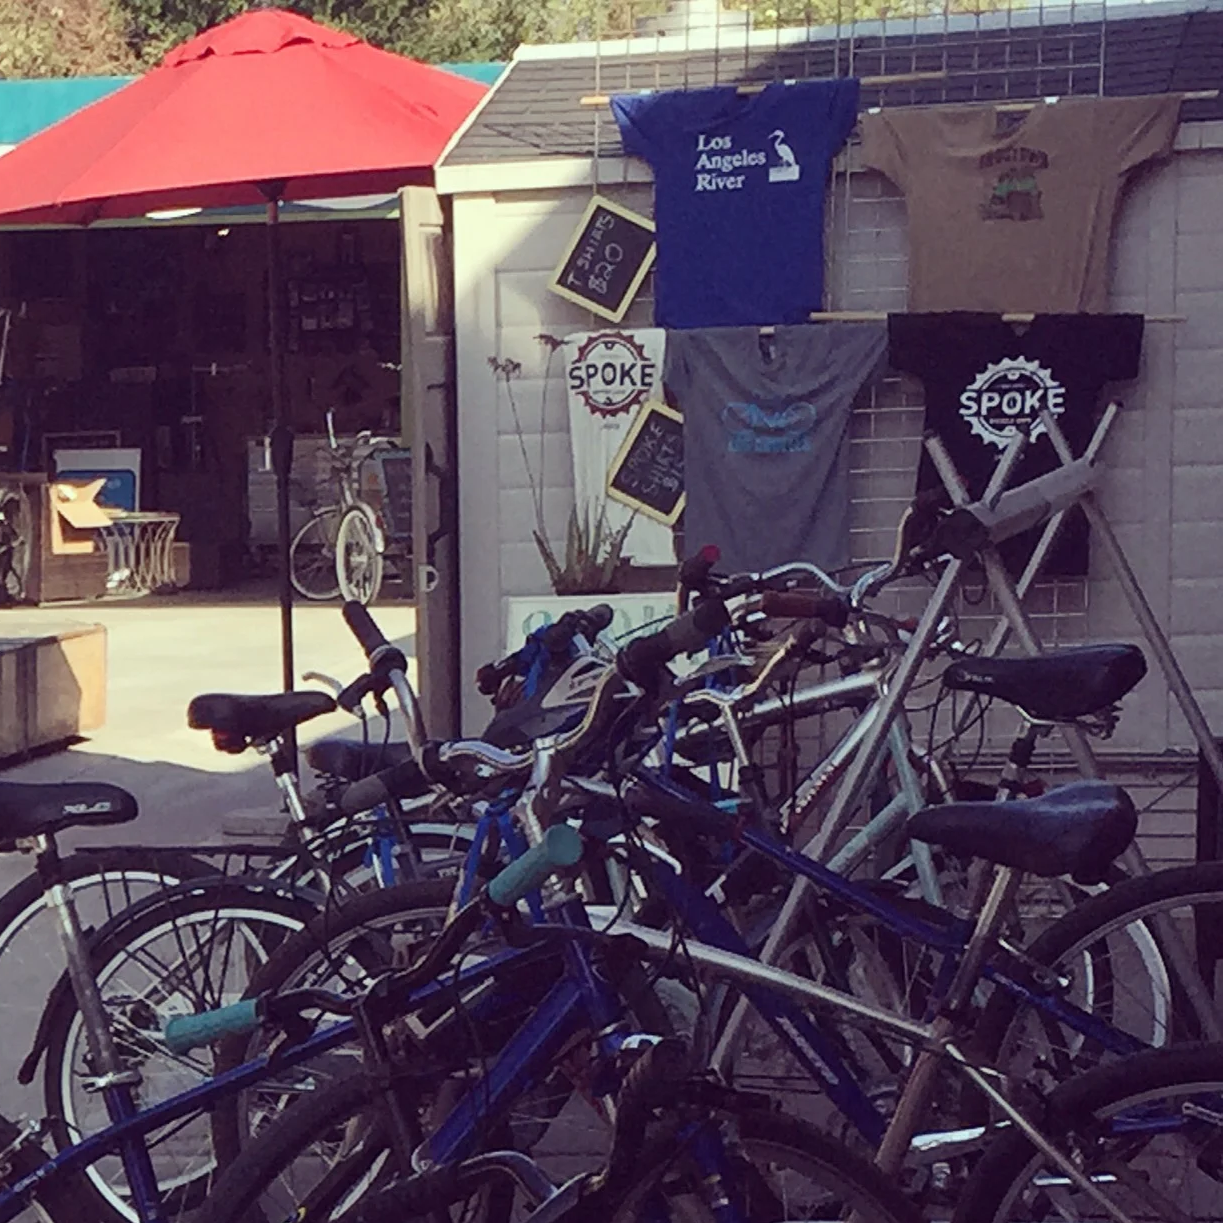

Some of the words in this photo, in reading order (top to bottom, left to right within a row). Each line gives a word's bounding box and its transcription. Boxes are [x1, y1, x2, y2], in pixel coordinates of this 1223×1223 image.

[697, 134, 732, 151] Los
[695, 149, 766, 172] Angeles
[695, 173, 745, 191] River
[588, 243, 623, 294] $20
[569, 362, 656, 390] SPOKE
[959, 387, 1066, 416] SPOKE
